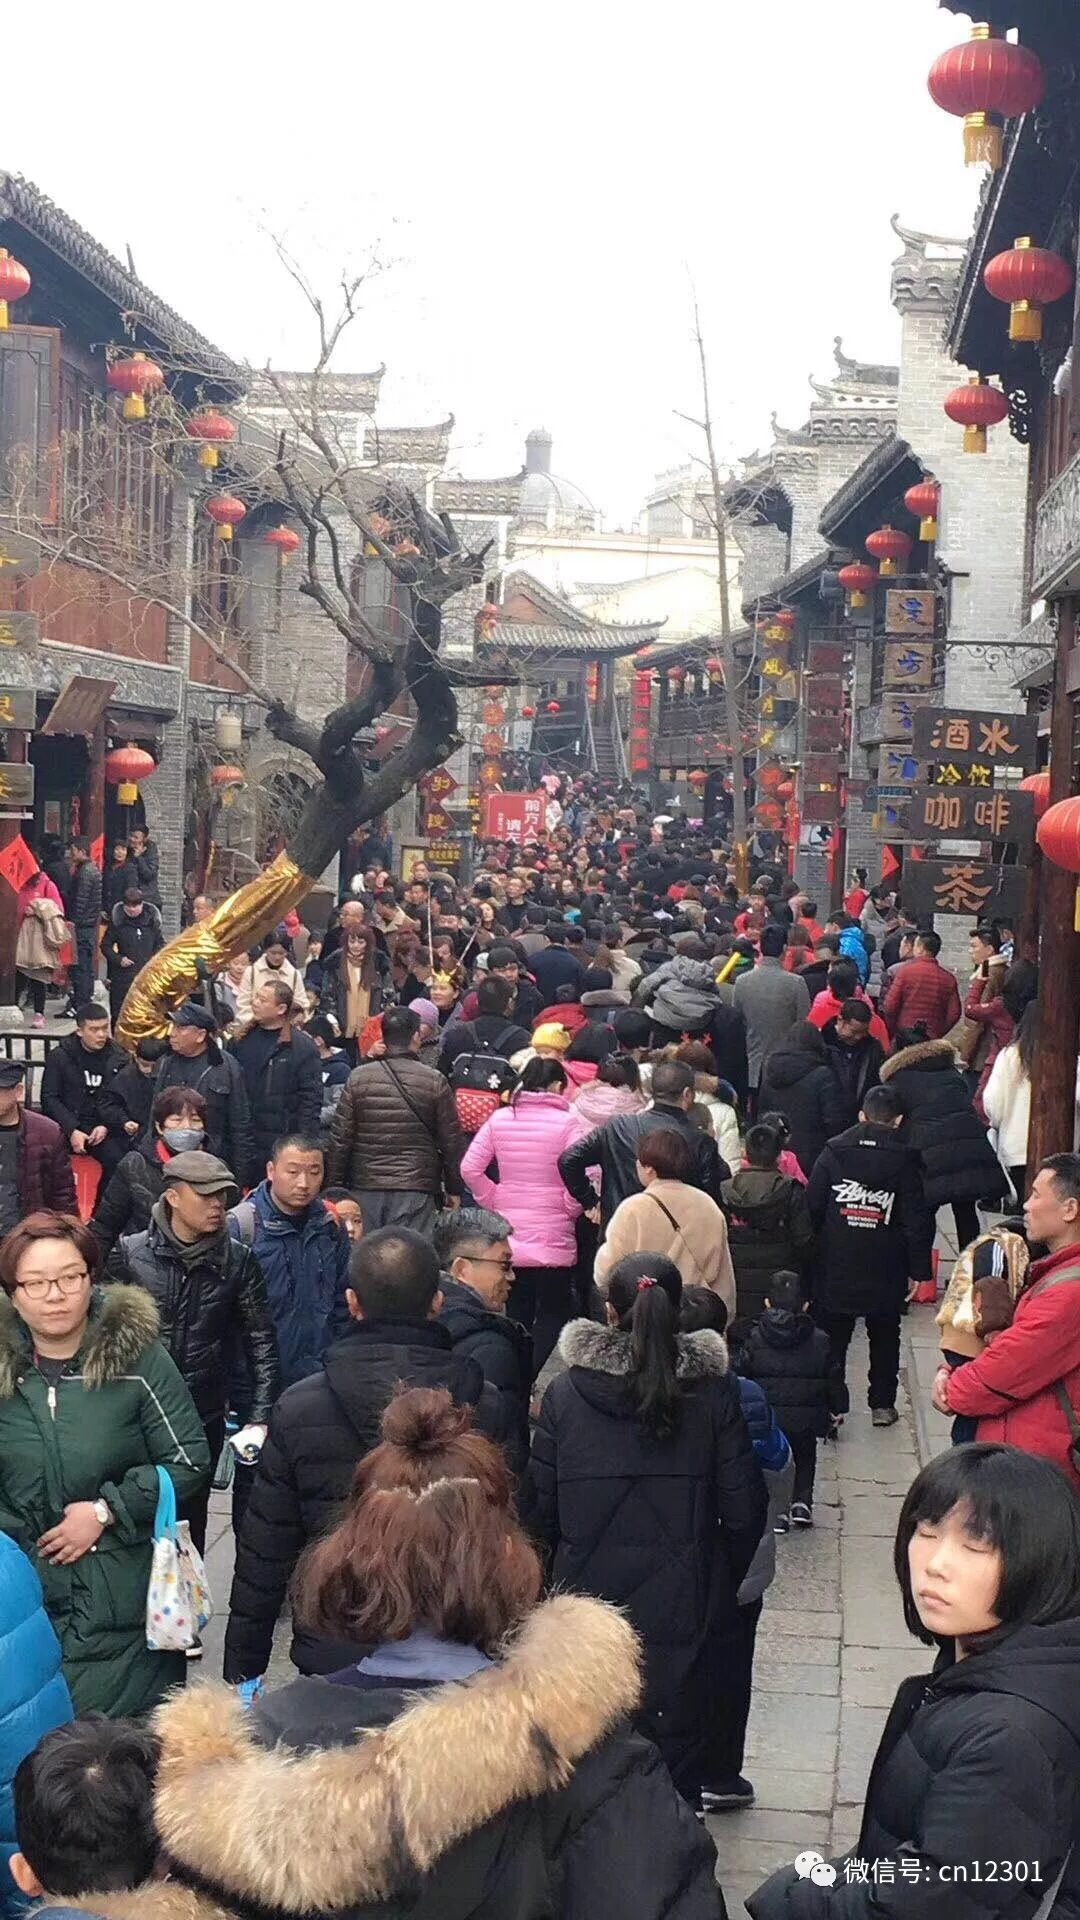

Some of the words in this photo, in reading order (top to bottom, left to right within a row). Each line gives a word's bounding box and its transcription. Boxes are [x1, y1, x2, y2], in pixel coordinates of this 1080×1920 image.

[930, 718, 1020, 756] 酒水
[923, 792, 1011, 836] 咖啡
[933, 863, 993, 911] 茶
